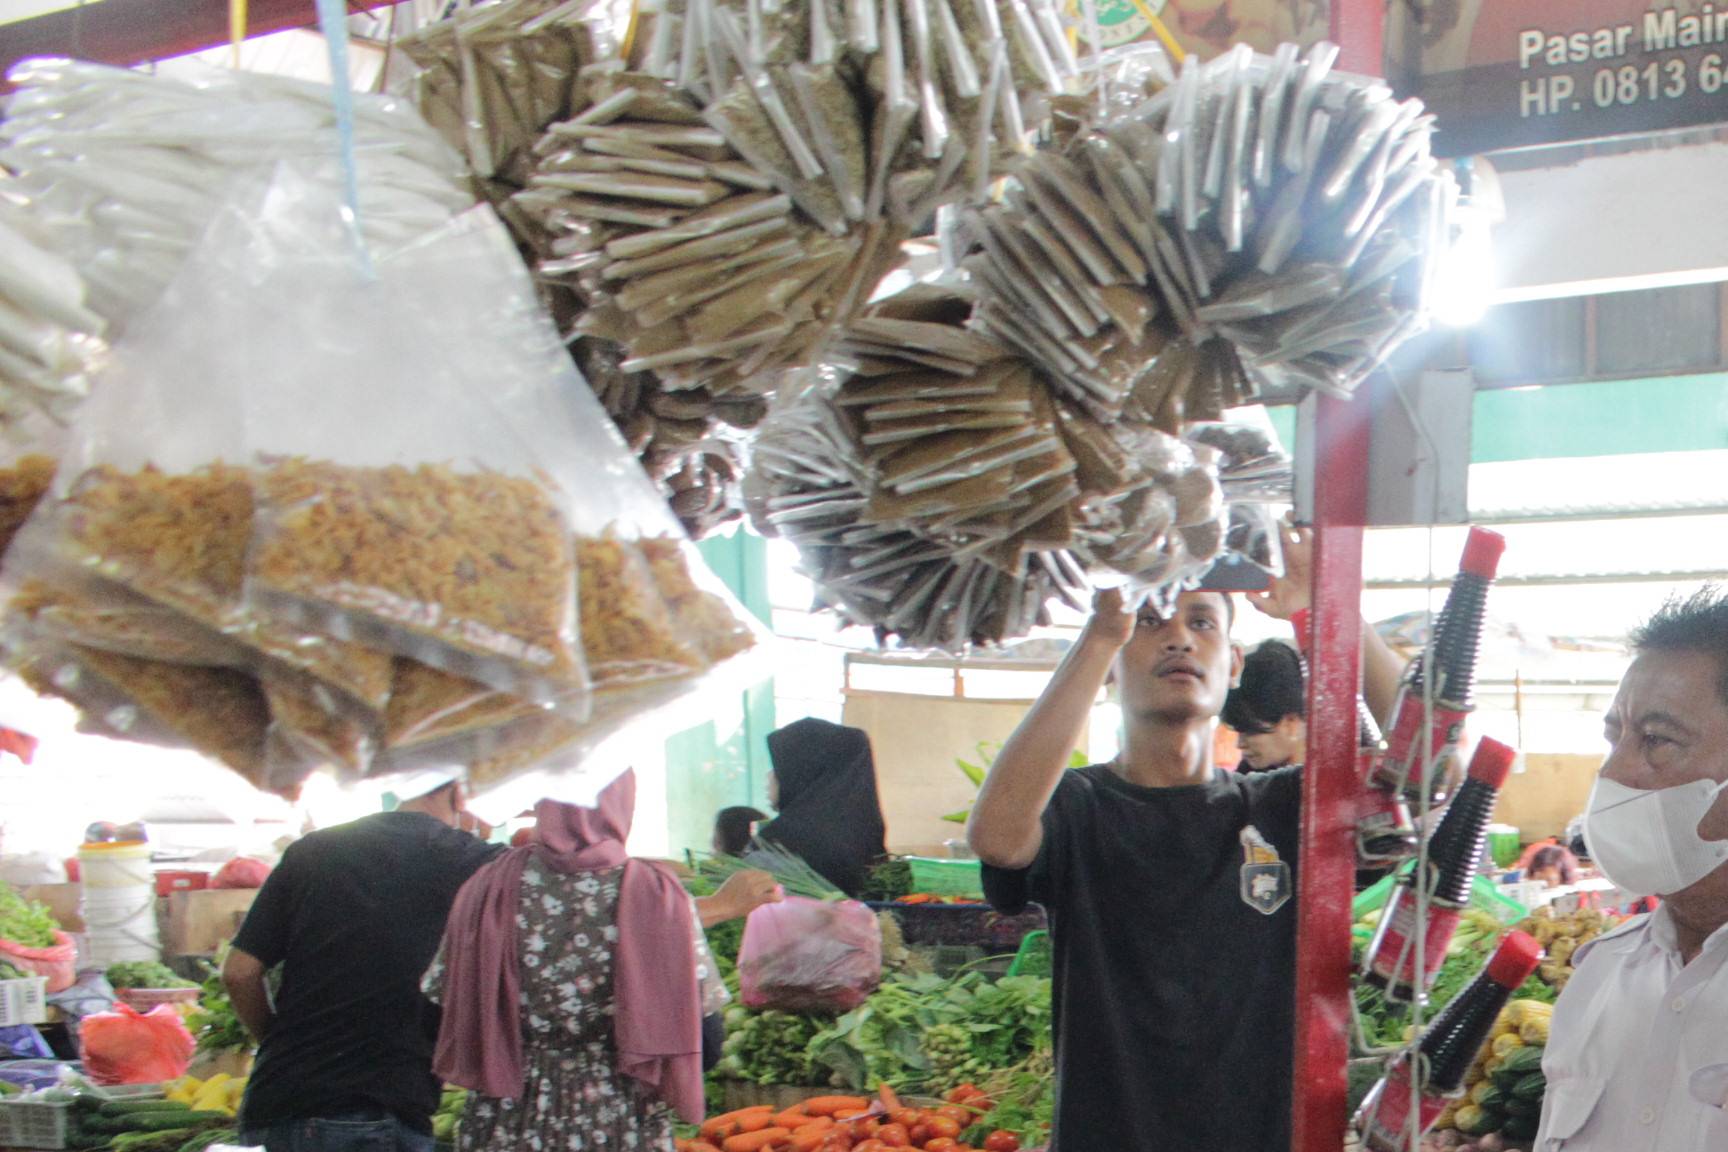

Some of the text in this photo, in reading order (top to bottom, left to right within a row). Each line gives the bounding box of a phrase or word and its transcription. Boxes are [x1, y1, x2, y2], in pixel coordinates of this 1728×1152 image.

[1518, 24, 1633, 69] Pasar
[1519, 75, 1581, 118] HP.
[1593, 59, 1687, 108] 0813
